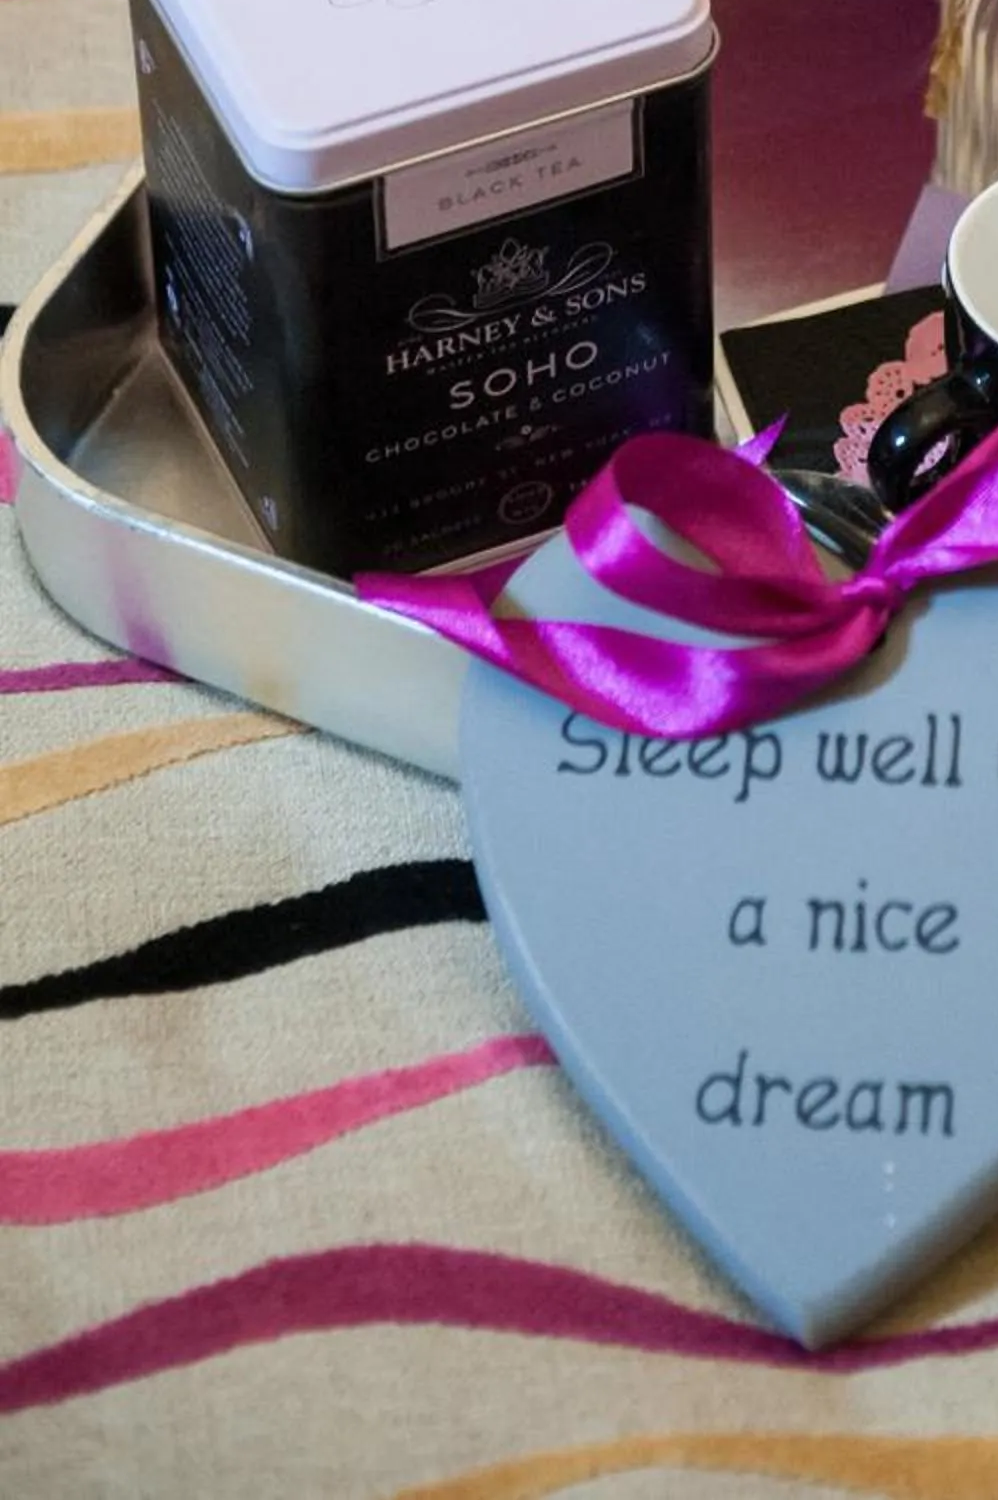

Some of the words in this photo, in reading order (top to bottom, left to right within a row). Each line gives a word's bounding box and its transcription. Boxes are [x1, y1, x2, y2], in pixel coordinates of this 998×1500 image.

[437, 177, 524, 212] BLACK
[536, 156, 583, 181] TEA
[386, 312, 520, 375] HARNEY
[530, 305, 557, 328] &
[565, 272, 648, 316] SONS
[364, 405, 518, 464] CHOCOLATE
[553, 352, 673, 402] COCONUT
[449, 341, 599, 410] SOHO
[815, 713, 963, 787] well
[728, 896, 767, 947] a
[807, 878, 961, 955] nice
[694, 1050, 956, 1137] dream
